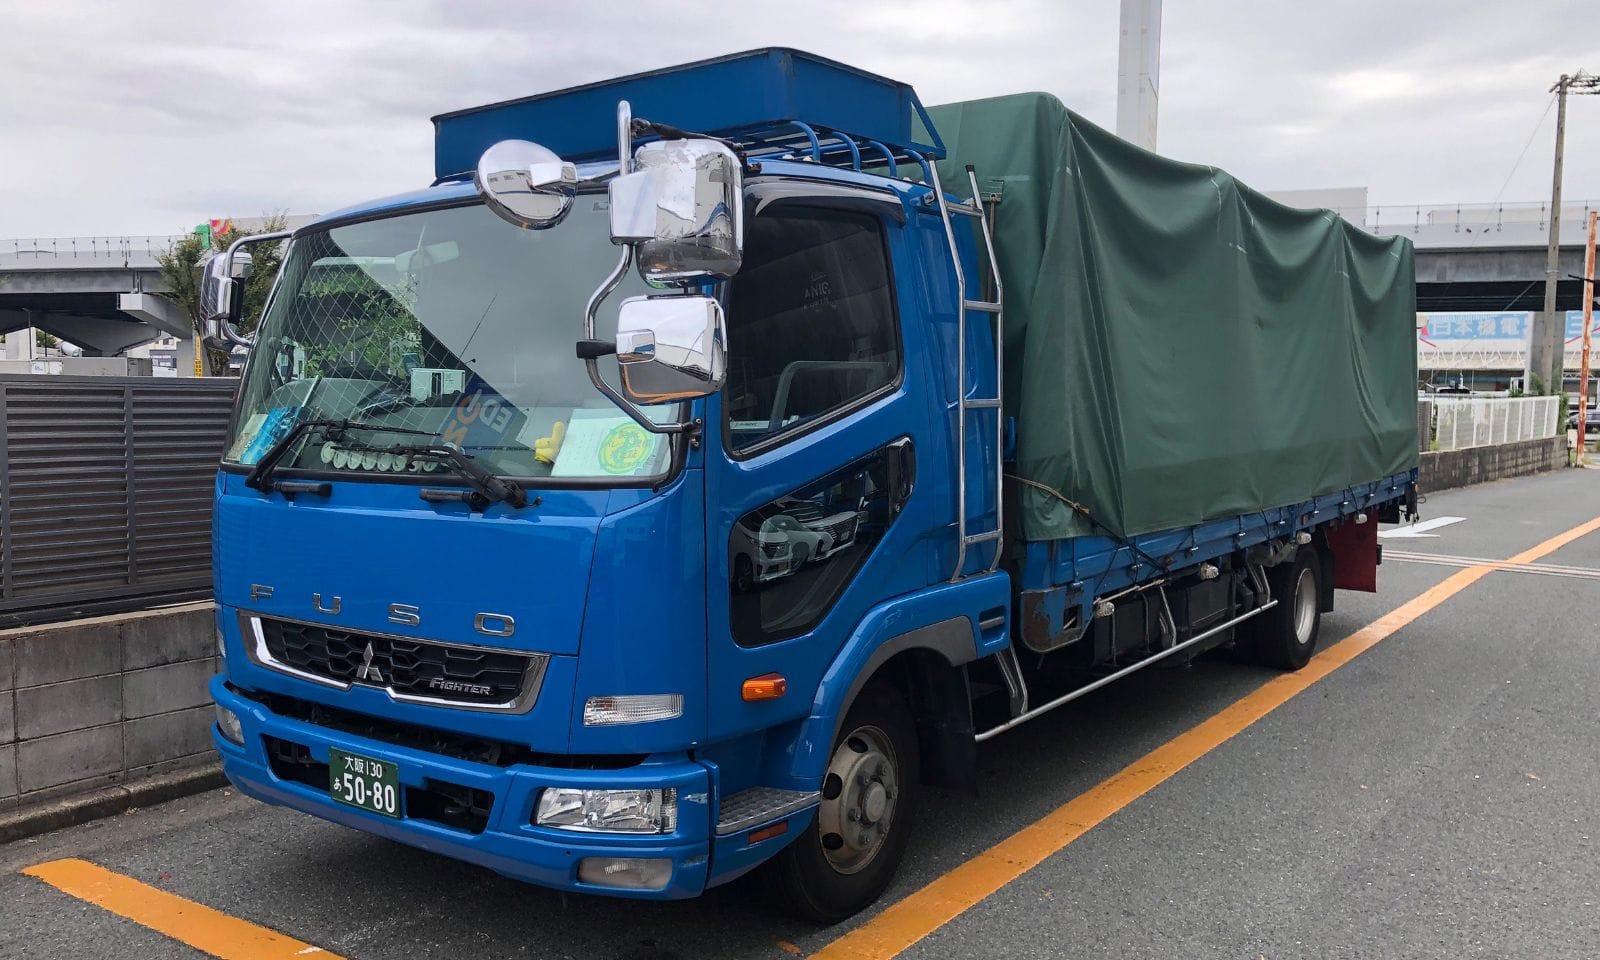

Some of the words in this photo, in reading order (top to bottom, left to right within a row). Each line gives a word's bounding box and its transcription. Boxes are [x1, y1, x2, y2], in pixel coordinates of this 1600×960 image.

[1433, 317, 1529, 336] 日本機電
[251, 583, 515, 637] FUSO
[429, 677, 492, 696] FIGHTER
[366, 760, 383, 779] 130
[333, 776, 342, 792] あ
[343, 772, 395, 813] 50-80
